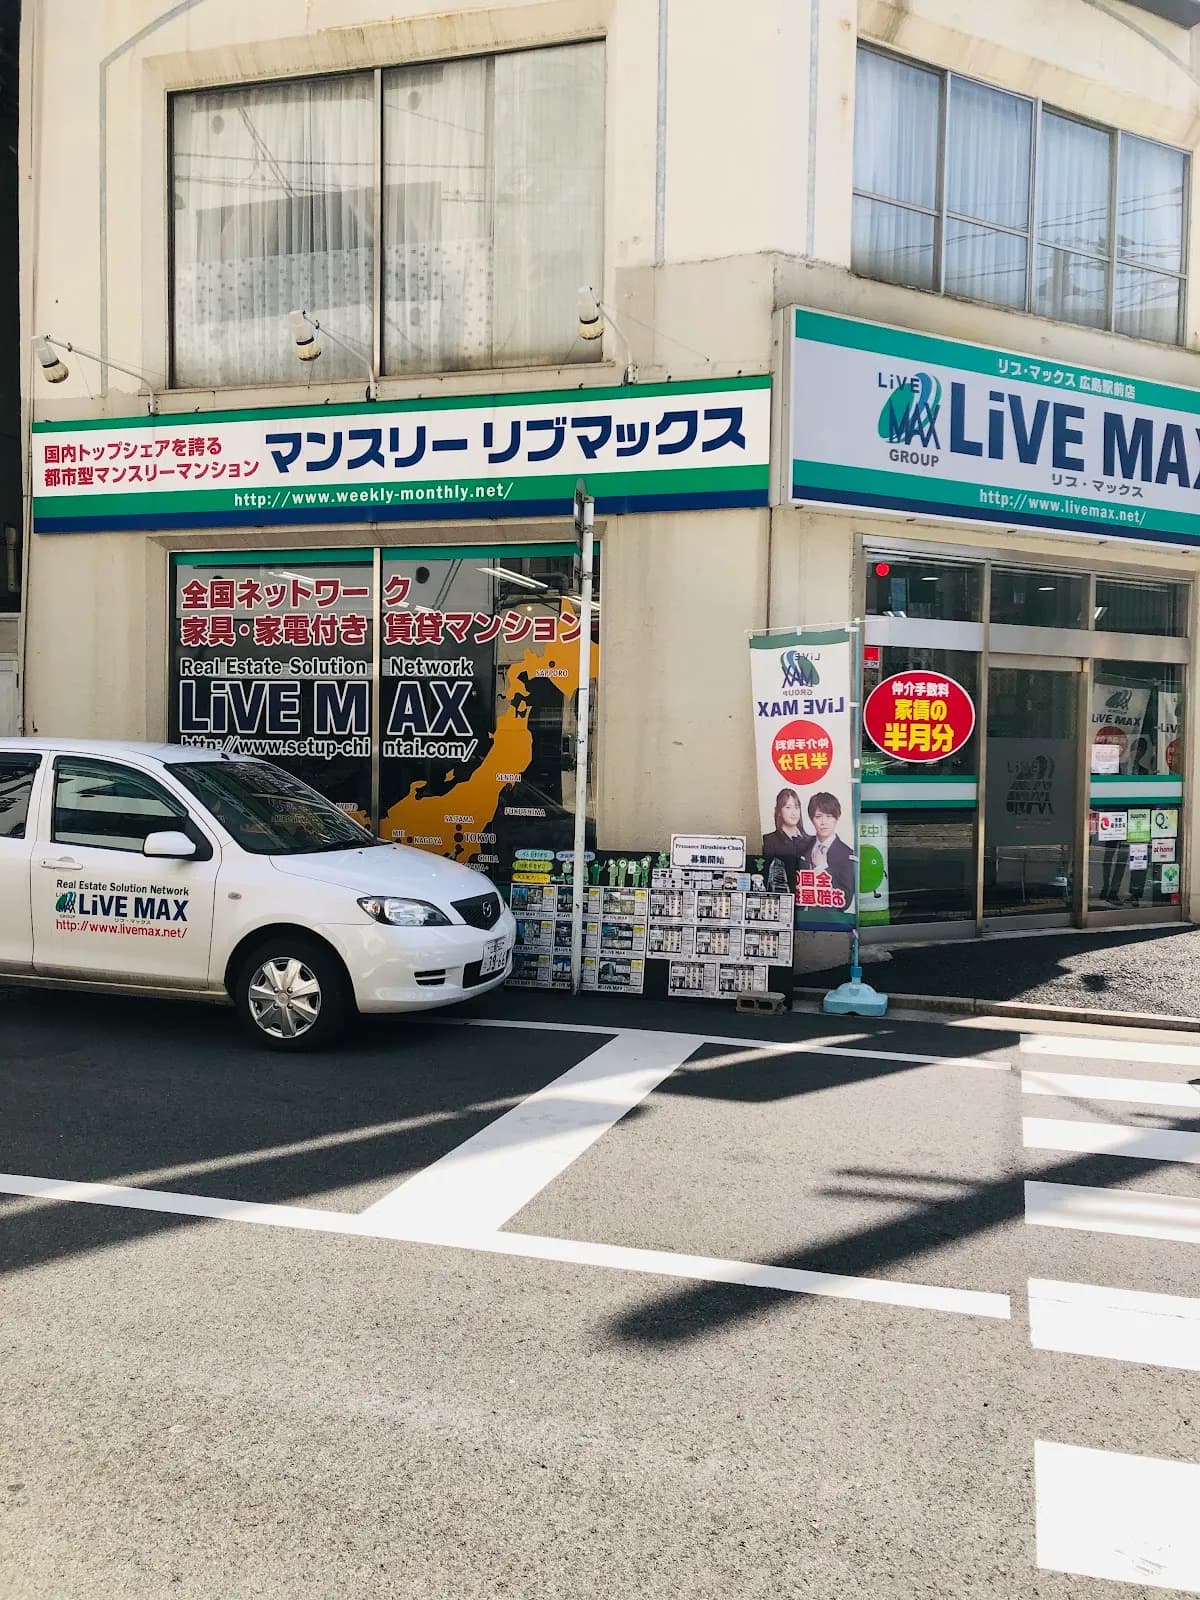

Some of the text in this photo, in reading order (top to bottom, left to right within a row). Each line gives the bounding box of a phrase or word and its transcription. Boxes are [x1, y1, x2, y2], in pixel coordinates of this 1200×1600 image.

[1080, 375, 1136, 400] 広島駅前店
[889, 397, 942, 450] MAX
[44, 435, 223, 464] 国内トップシェアを誇る
[264, 406, 747, 474] マンスリー リブマックス
[889, 449, 940, 467] GROUP
[44, 459, 260, 488] 都市型マンスリーマンション
[233, 481, 515, 509] http://www.weekly-monthly.net/
[979, 489, 1148, 527] http://www.livemax.net/
[180, 656, 474, 677] Real Estate Solution Network
[891, 681, 950, 697] 仲介手数料
[894, 698, 948, 721] 家賃の
[884, 722, 955, 753] 半月分
[495, 772, 522, 782] SENDAI
[504, 807, 546, 817] FUKUSHIMA
[413, 836, 442, 846] NAGOYA
[464, 832, 497, 844] TOKYO
[56, 879, 189, 896] Real Estate Solution Network
[134, 896, 189, 922] MAX
[56, 919, 188, 939] http://www.livemax.net/
